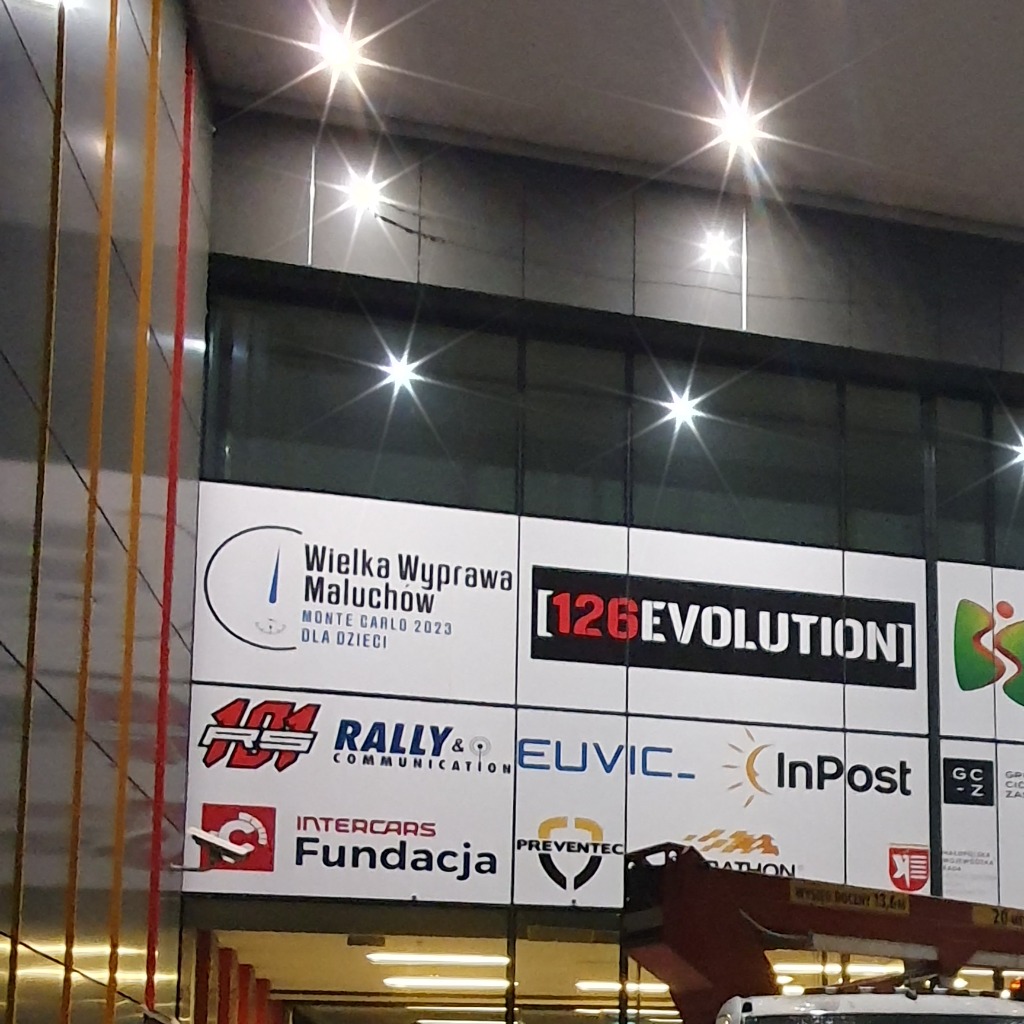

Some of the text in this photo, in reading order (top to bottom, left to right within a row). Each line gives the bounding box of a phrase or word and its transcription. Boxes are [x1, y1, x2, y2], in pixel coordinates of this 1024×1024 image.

[304, 543, 513, 592] Wielka Wyprawa
[304, 576, 435, 613] Maluchów
[302, 610, 453, 635] MONTE CARLO 2023
[301, 628, 387, 649] DLA DZIECI
[334, 719, 464, 757] RALLY &
[332, 752, 511, 774] COMMUNICATION
[777, 752, 911, 796] InPost
[297, 816, 437, 837] INTERCARS
[295, 837, 497, 881] Fundacja
[516, 839, 624, 855] PREVENTEC
